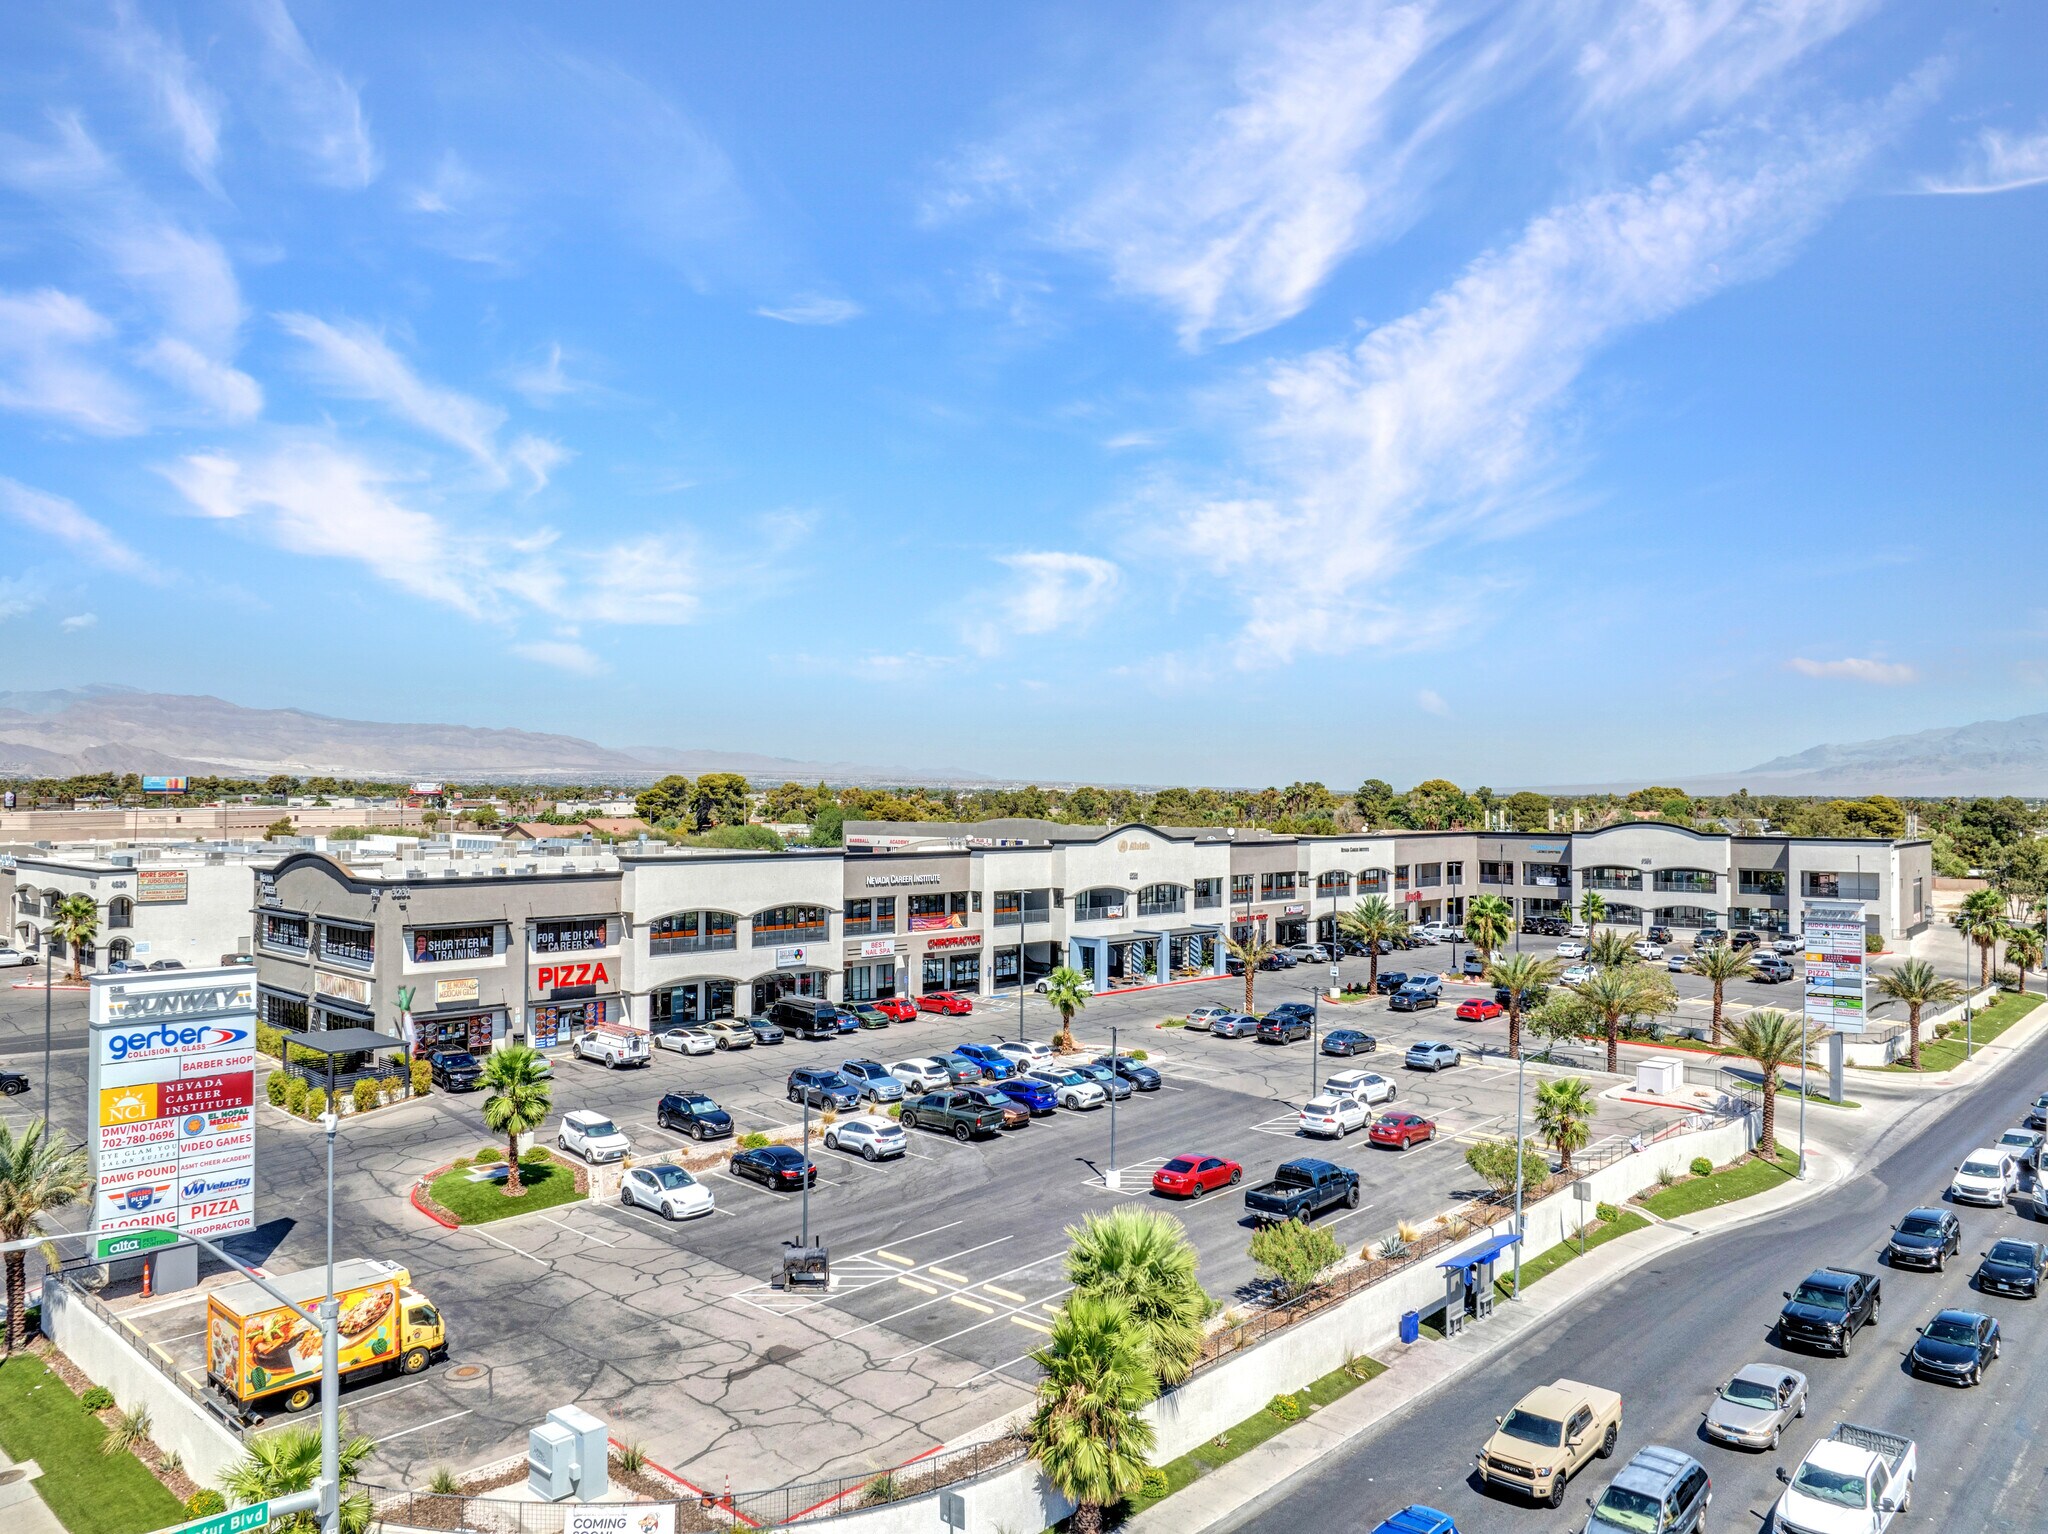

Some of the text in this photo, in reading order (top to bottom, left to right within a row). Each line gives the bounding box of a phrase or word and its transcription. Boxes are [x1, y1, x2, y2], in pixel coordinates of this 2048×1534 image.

[866, 873, 940, 885] NEVADA CAREER INSTITUTE
[537, 929, 600, 943] FOR MEDICAL
[548, 940, 589, 952] CAREERS
[538, 962, 609, 991] PIZZA
[1808, 969, 1830, 977] PIZZA
[109, 1023, 212, 1060] gerber
[128, 1047, 170, 1059] COLLISION
[181, 1044, 206, 1053] GLASS
[182, 1055, 253, 1071] BARBER SHOP
[165, 1078, 223, 1093] NEVADA
[165, 1089, 221, 1104] CAREER
[109, 1104, 147, 1122] NCI
[165, 1097, 243, 1115] INSTITUTE
[208, 1112, 218, 1120] EL
[209, 1114, 249, 1126] MEXICAN
[102, 1118, 175, 1138] DMV/NOTARY
[102, 1130, 175, 1149] 702-780-0696
[180, 1133, 252, 1153] VIDEO GAMES
[101, 1143, 177, 1160] EYE GLAM YOU
[102, 1158, 135, 1168] SALON
[180, 1153, 251, 1171] ASMT CHEER ACADEMY
[101, 1165, 177, 1185] DAWG POUND
[206, 1177, 251, 1191] Velocity
[127, 1188, 152, 1198] TRANS
[131, 1195, 149, 1203] PLUS
[191, 1199, 240, 1220] PIZZA
[109, 1239, 140, 1253] alta
[230, 1508, 263, 1531] Blvd
[573, 1518, 627, 1529] COMING
